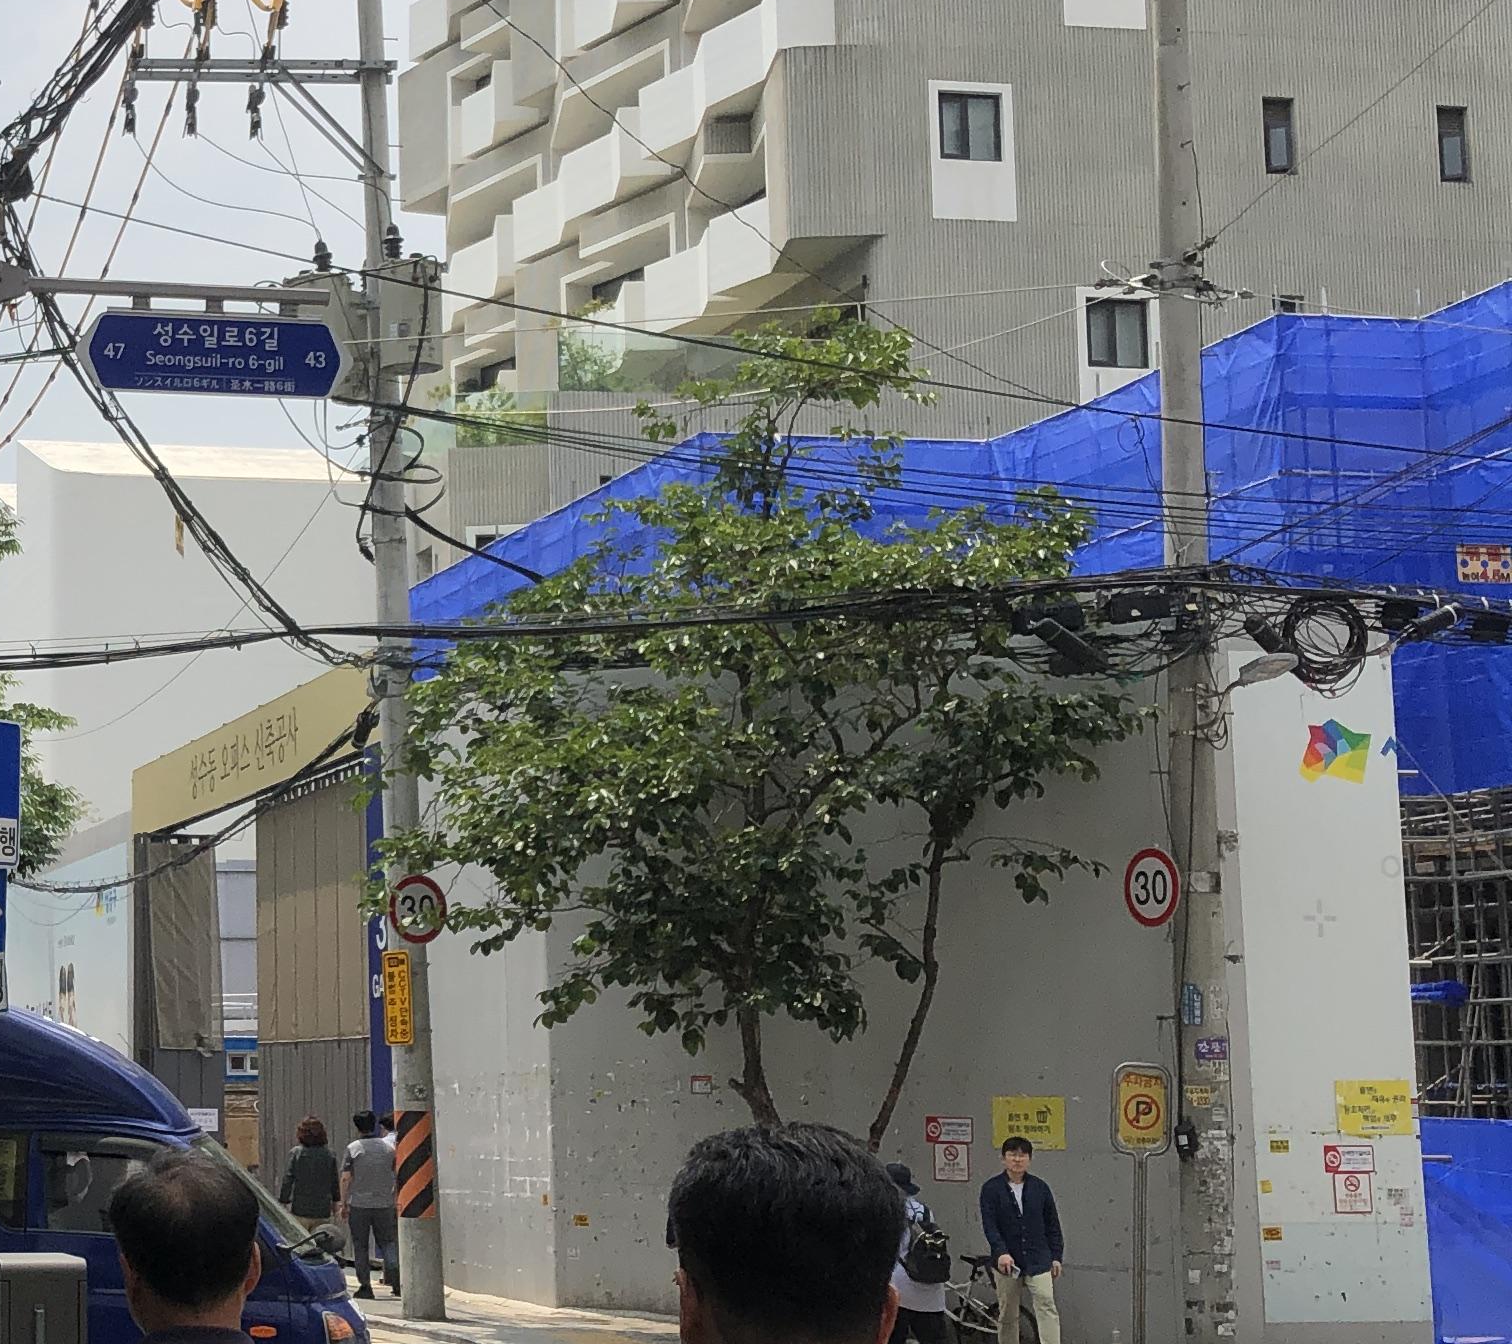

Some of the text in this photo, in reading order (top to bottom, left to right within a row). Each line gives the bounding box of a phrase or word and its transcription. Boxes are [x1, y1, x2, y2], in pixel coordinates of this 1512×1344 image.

[152, 322, 279, 351] 성수일로6길
[103, 343, 125, 359] 47
[145, 350, 285, 373] Seongsuil-ro 6-gil
[304, 352, 326, 367] 43
[190, 706, 299, 800] 성수동 오피스 신축공사
[1134, 869, 1168, 906] 30
[400, 895, 435, 919] 30
